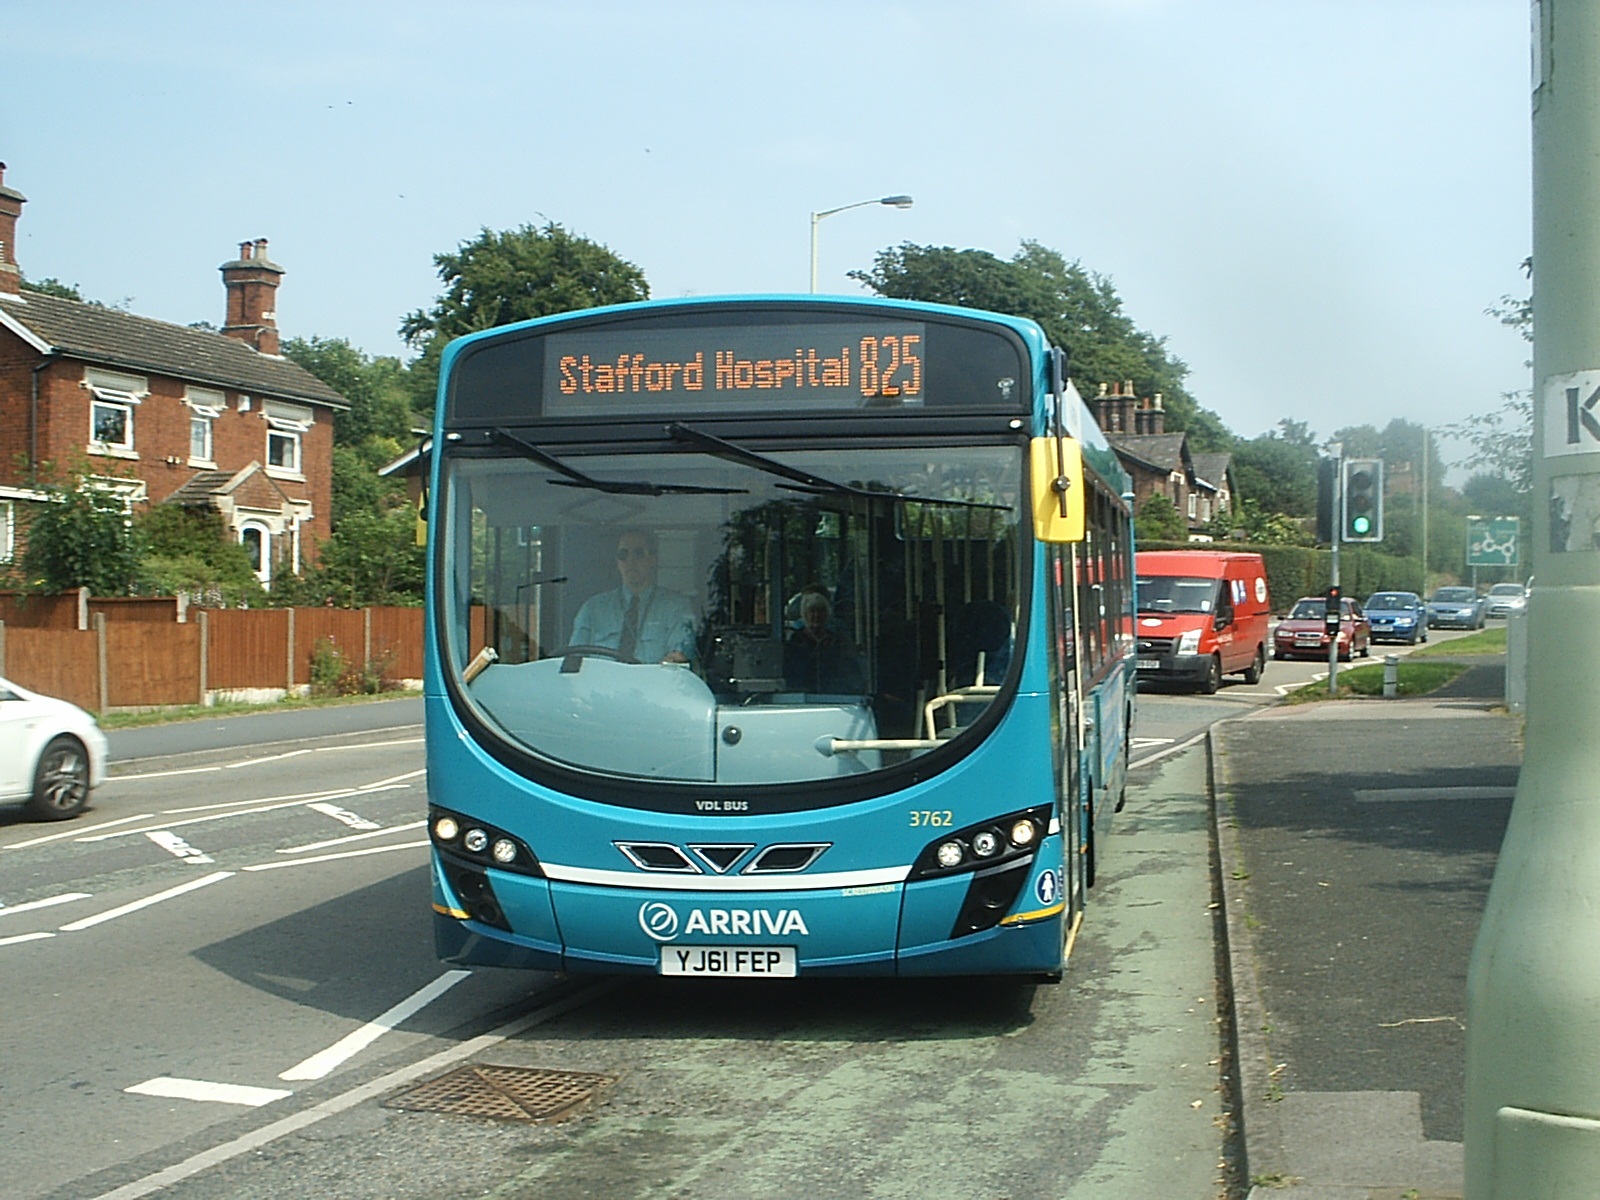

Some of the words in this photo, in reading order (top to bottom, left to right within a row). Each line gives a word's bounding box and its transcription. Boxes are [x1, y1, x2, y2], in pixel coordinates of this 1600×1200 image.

[559, 352, 703, 394] Stafford
[715, 347, 850, 390] Hospital
[859, 334, 921, 396] 825
[695, 800, 721, 811] VDL
[723, 800, 749, 811] BUS
[909, 810, 953, 827] 3762
[684, 909, 809, 935] ARRIVA
[677, 950, 728, 972] YJ61
[736, 951, 780, 972] FEP
